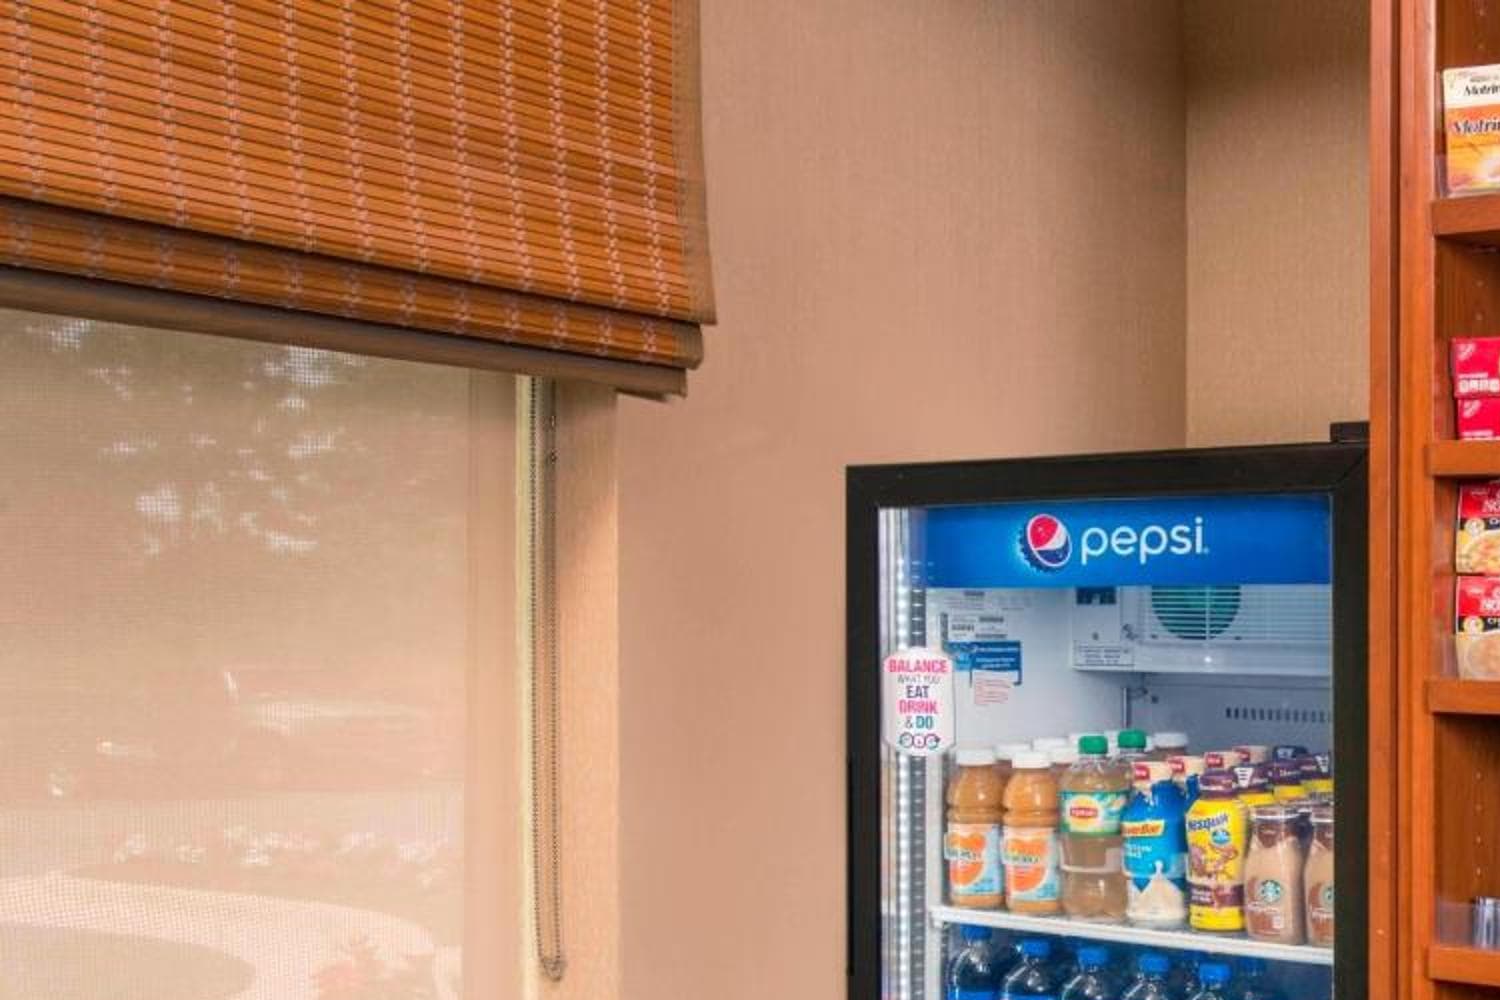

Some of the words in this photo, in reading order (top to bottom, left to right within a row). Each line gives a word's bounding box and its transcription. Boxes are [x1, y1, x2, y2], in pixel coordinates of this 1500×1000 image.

[1080, 517, 1204, 565] pepsi
[888, 658, 949, 674] BALANCE
[905, 685, 930, 699] EAT
[898, 700, 938, 715] DRINK
[915, 715, 934, 730] DO
